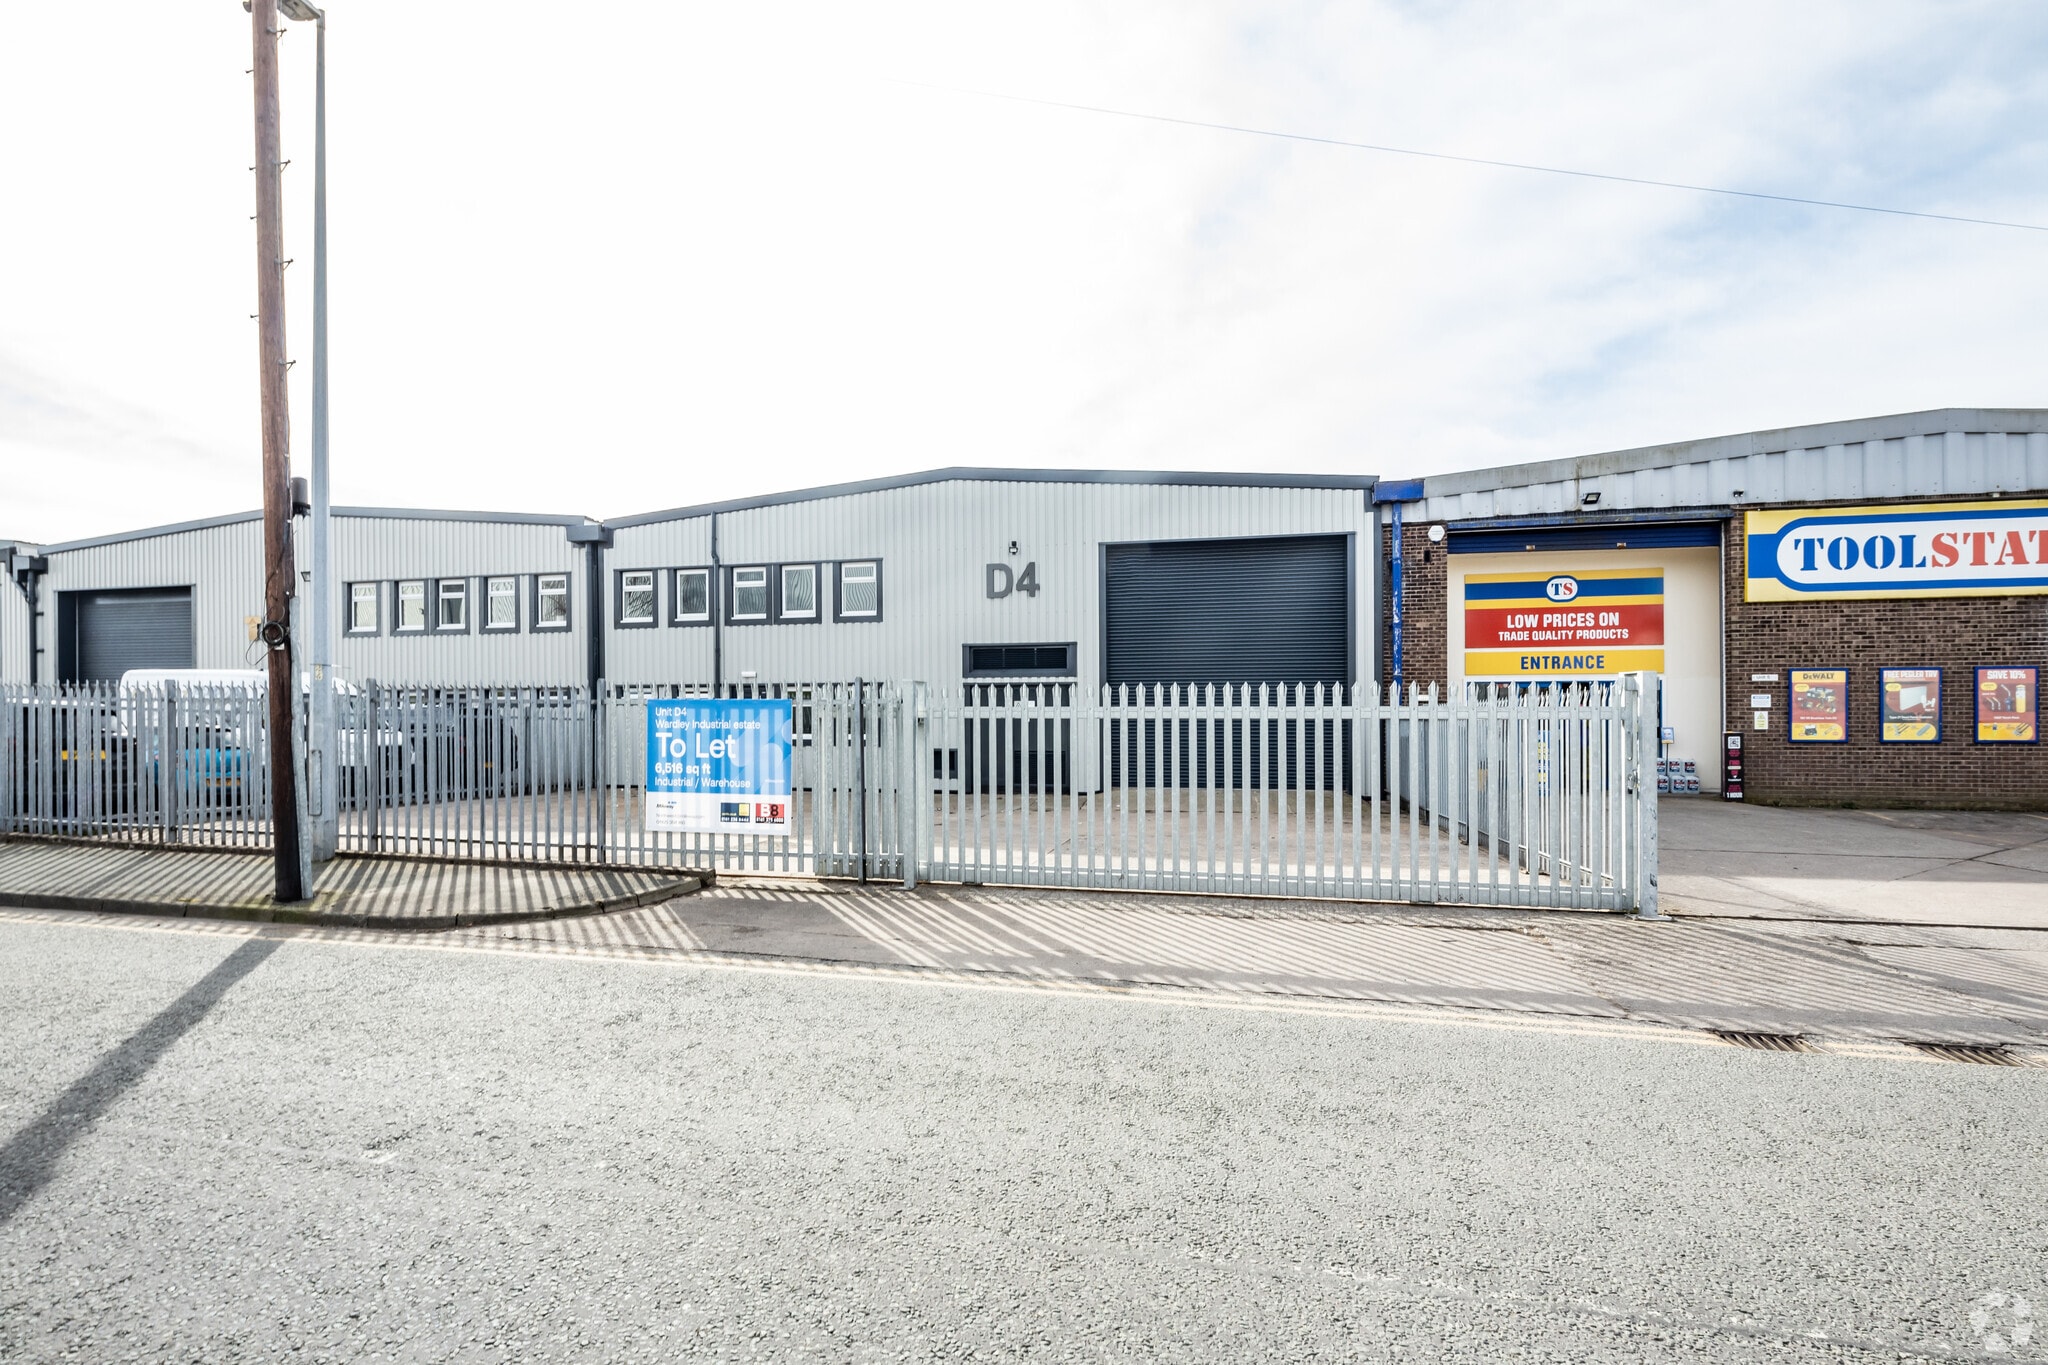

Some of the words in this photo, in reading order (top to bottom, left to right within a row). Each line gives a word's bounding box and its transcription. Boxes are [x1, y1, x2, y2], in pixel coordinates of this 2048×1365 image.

[985, 561, 1041, 599] D4
[1551, 582, 1573, 596] TS
[1507, 614, 1539, 628] LOW
[1543, 612, 1595, 628] PRICES
[1599, 611, 1620, 626] ON
[1498, 630, 1530, 641] TRADE
[1532, 629, 1574, 641] QUALITY
[1576, 628, 1629, 640] PRODUCTS
[1520, 655, 1605, 670] ENTRANCE
[1987, 670, 2009, 680] SAVE
[2010, 670, 2026, 679] 10%
[655, 707, 673, 717] Unit
[674, 707, 687, 717] D4
[655, 719, 689, 731] Wardley
[692, 719, 731, 730] Industrial
[733, 720, 761, 730] estate
[655, 732, 687, 759] To
[695, 732, 737, 759] Let
[654, 762, 683, 776] 6,516
[685, 765, 700, 776] sq
[702, 762, 711, 774] ft
[654, 776, 694, 787] Industrial
[694, 778, 700, 789] /
[701, 778, 751, 789] Warehouse
[760, 803, 779, 817] B8
